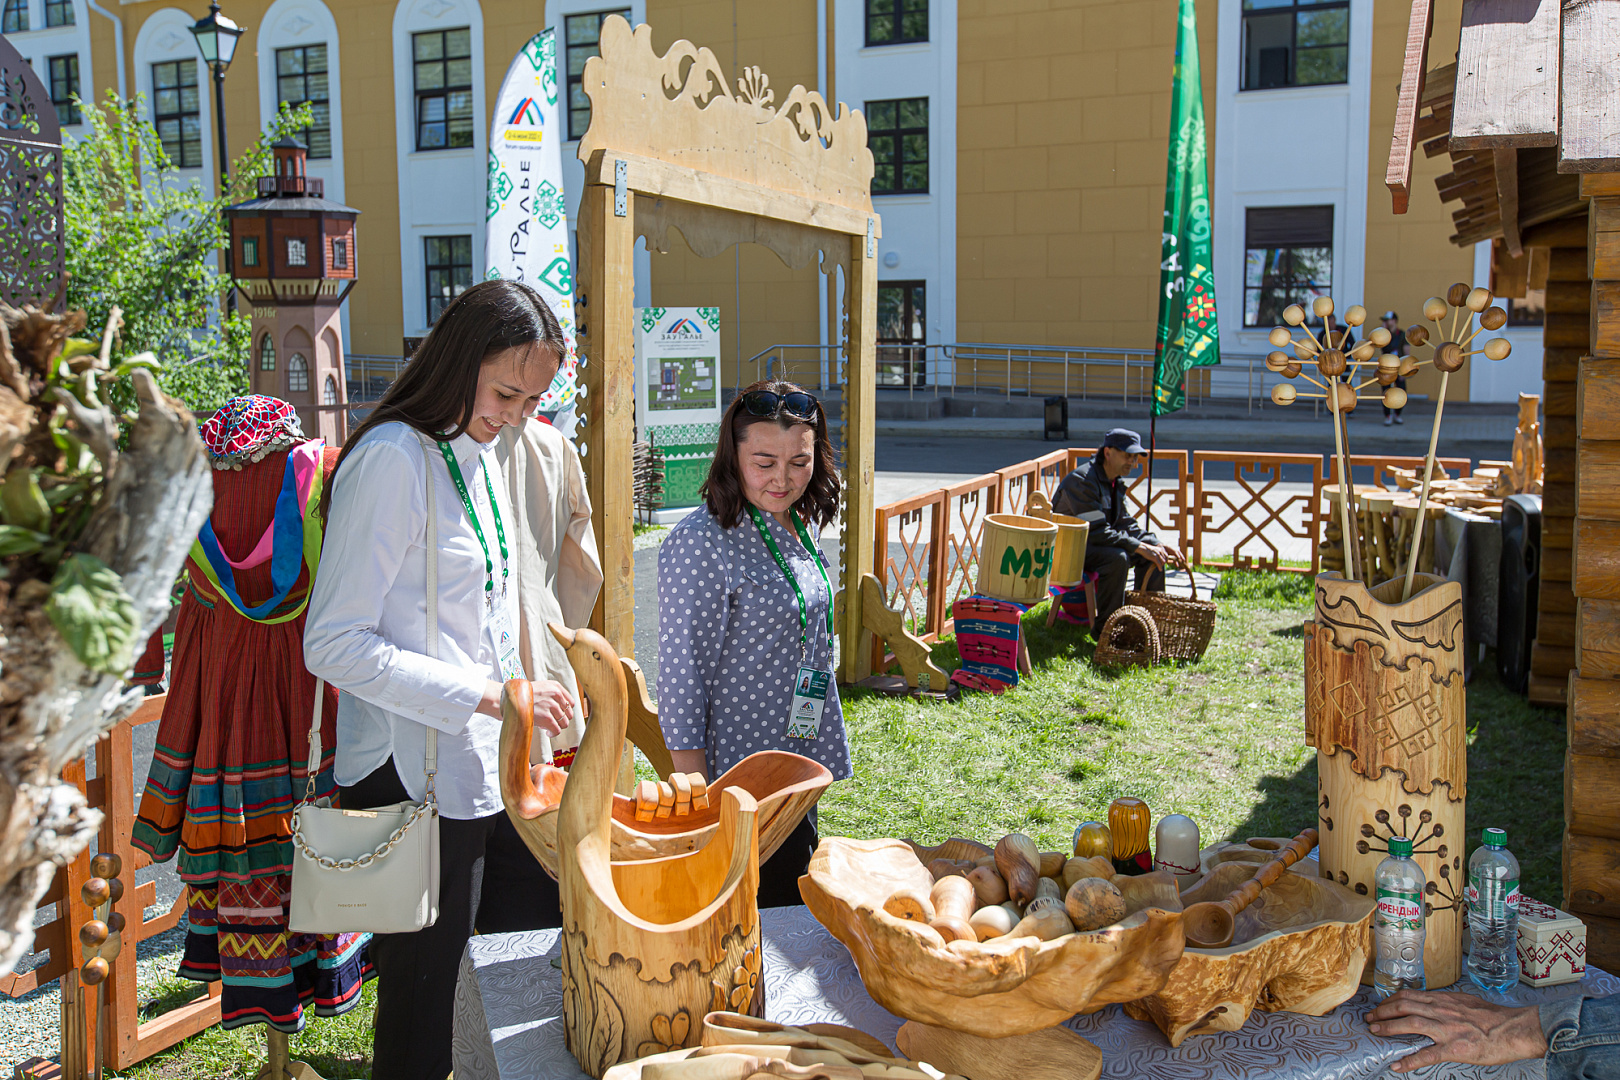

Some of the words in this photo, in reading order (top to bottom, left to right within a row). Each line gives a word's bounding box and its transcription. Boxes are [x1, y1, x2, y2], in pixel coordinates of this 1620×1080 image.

[510, 161, 530, 282] УРАЛЬЕ
[661, 330, 703, 340] ЗАУРАЛЬЕ
[1377, 901, 1420, 917] ИРЕНДЫК
